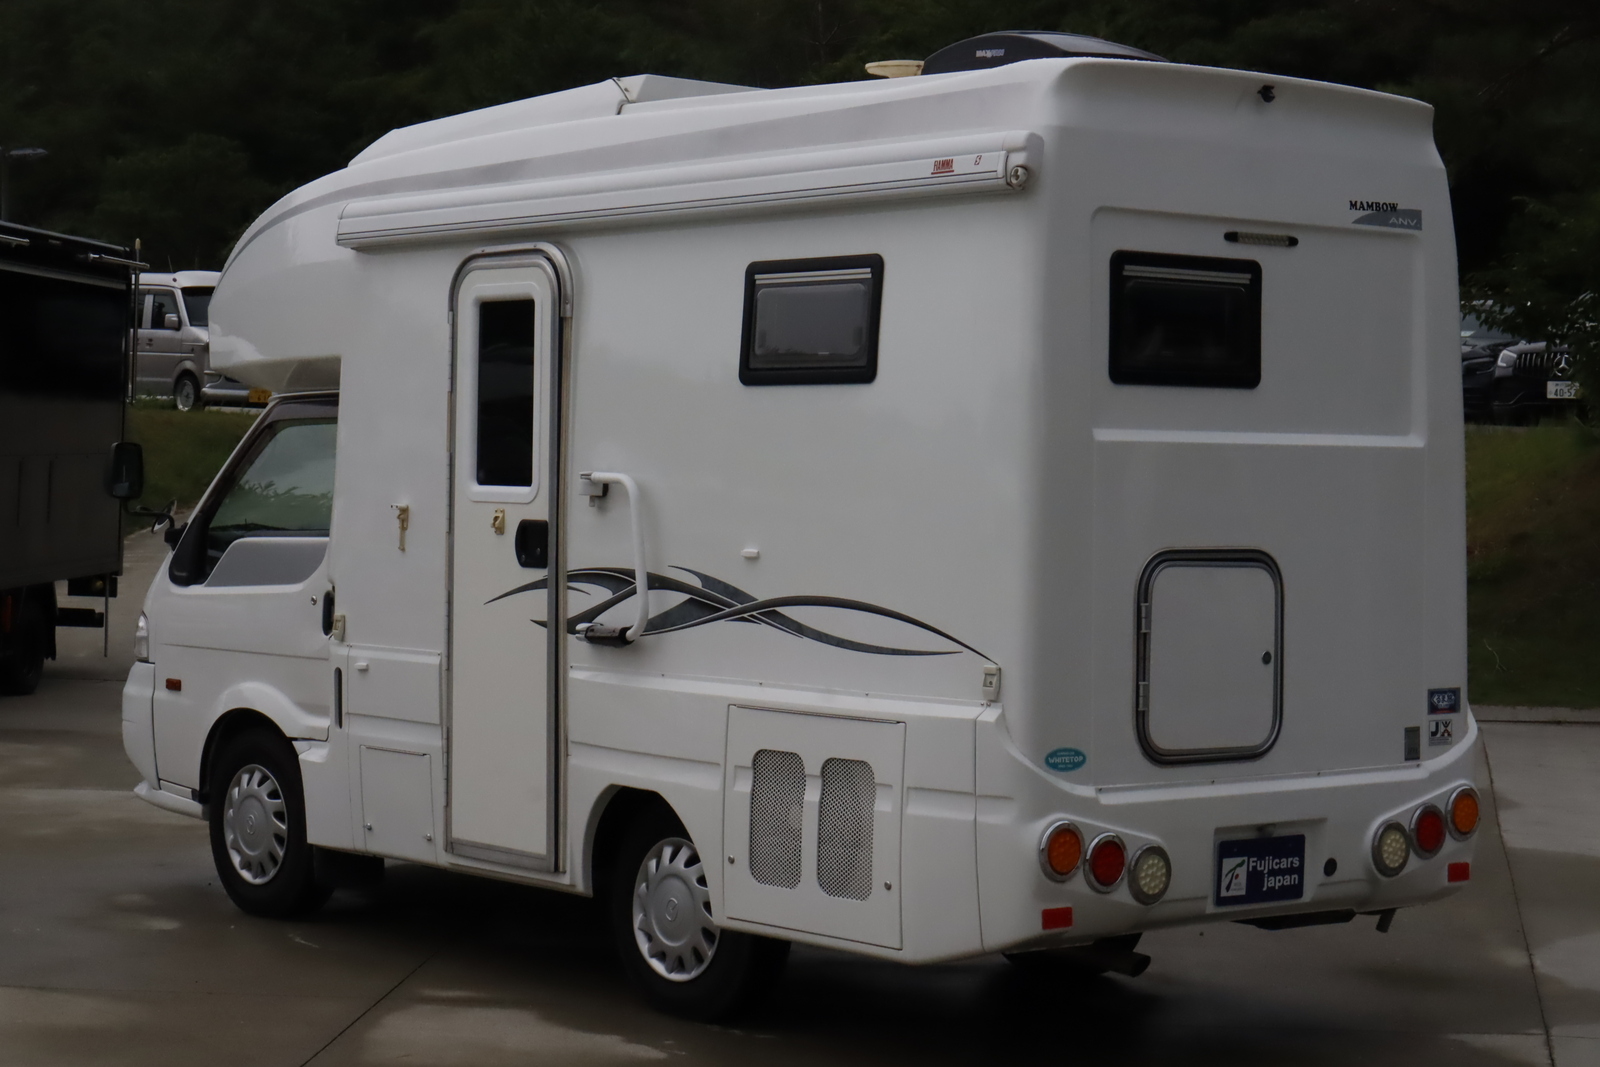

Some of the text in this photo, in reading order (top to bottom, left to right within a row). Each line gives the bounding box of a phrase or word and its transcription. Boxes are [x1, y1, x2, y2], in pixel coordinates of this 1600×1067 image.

[932, 158, 954, 172] FIAMMA
[1349, 200, 1399, 213] MAMBOW
[1048, 755, 1084, 764] WHITETOP
[1248, 855, 1300, 874] Fujicars
[1262, 873, 1299, 892] japan
